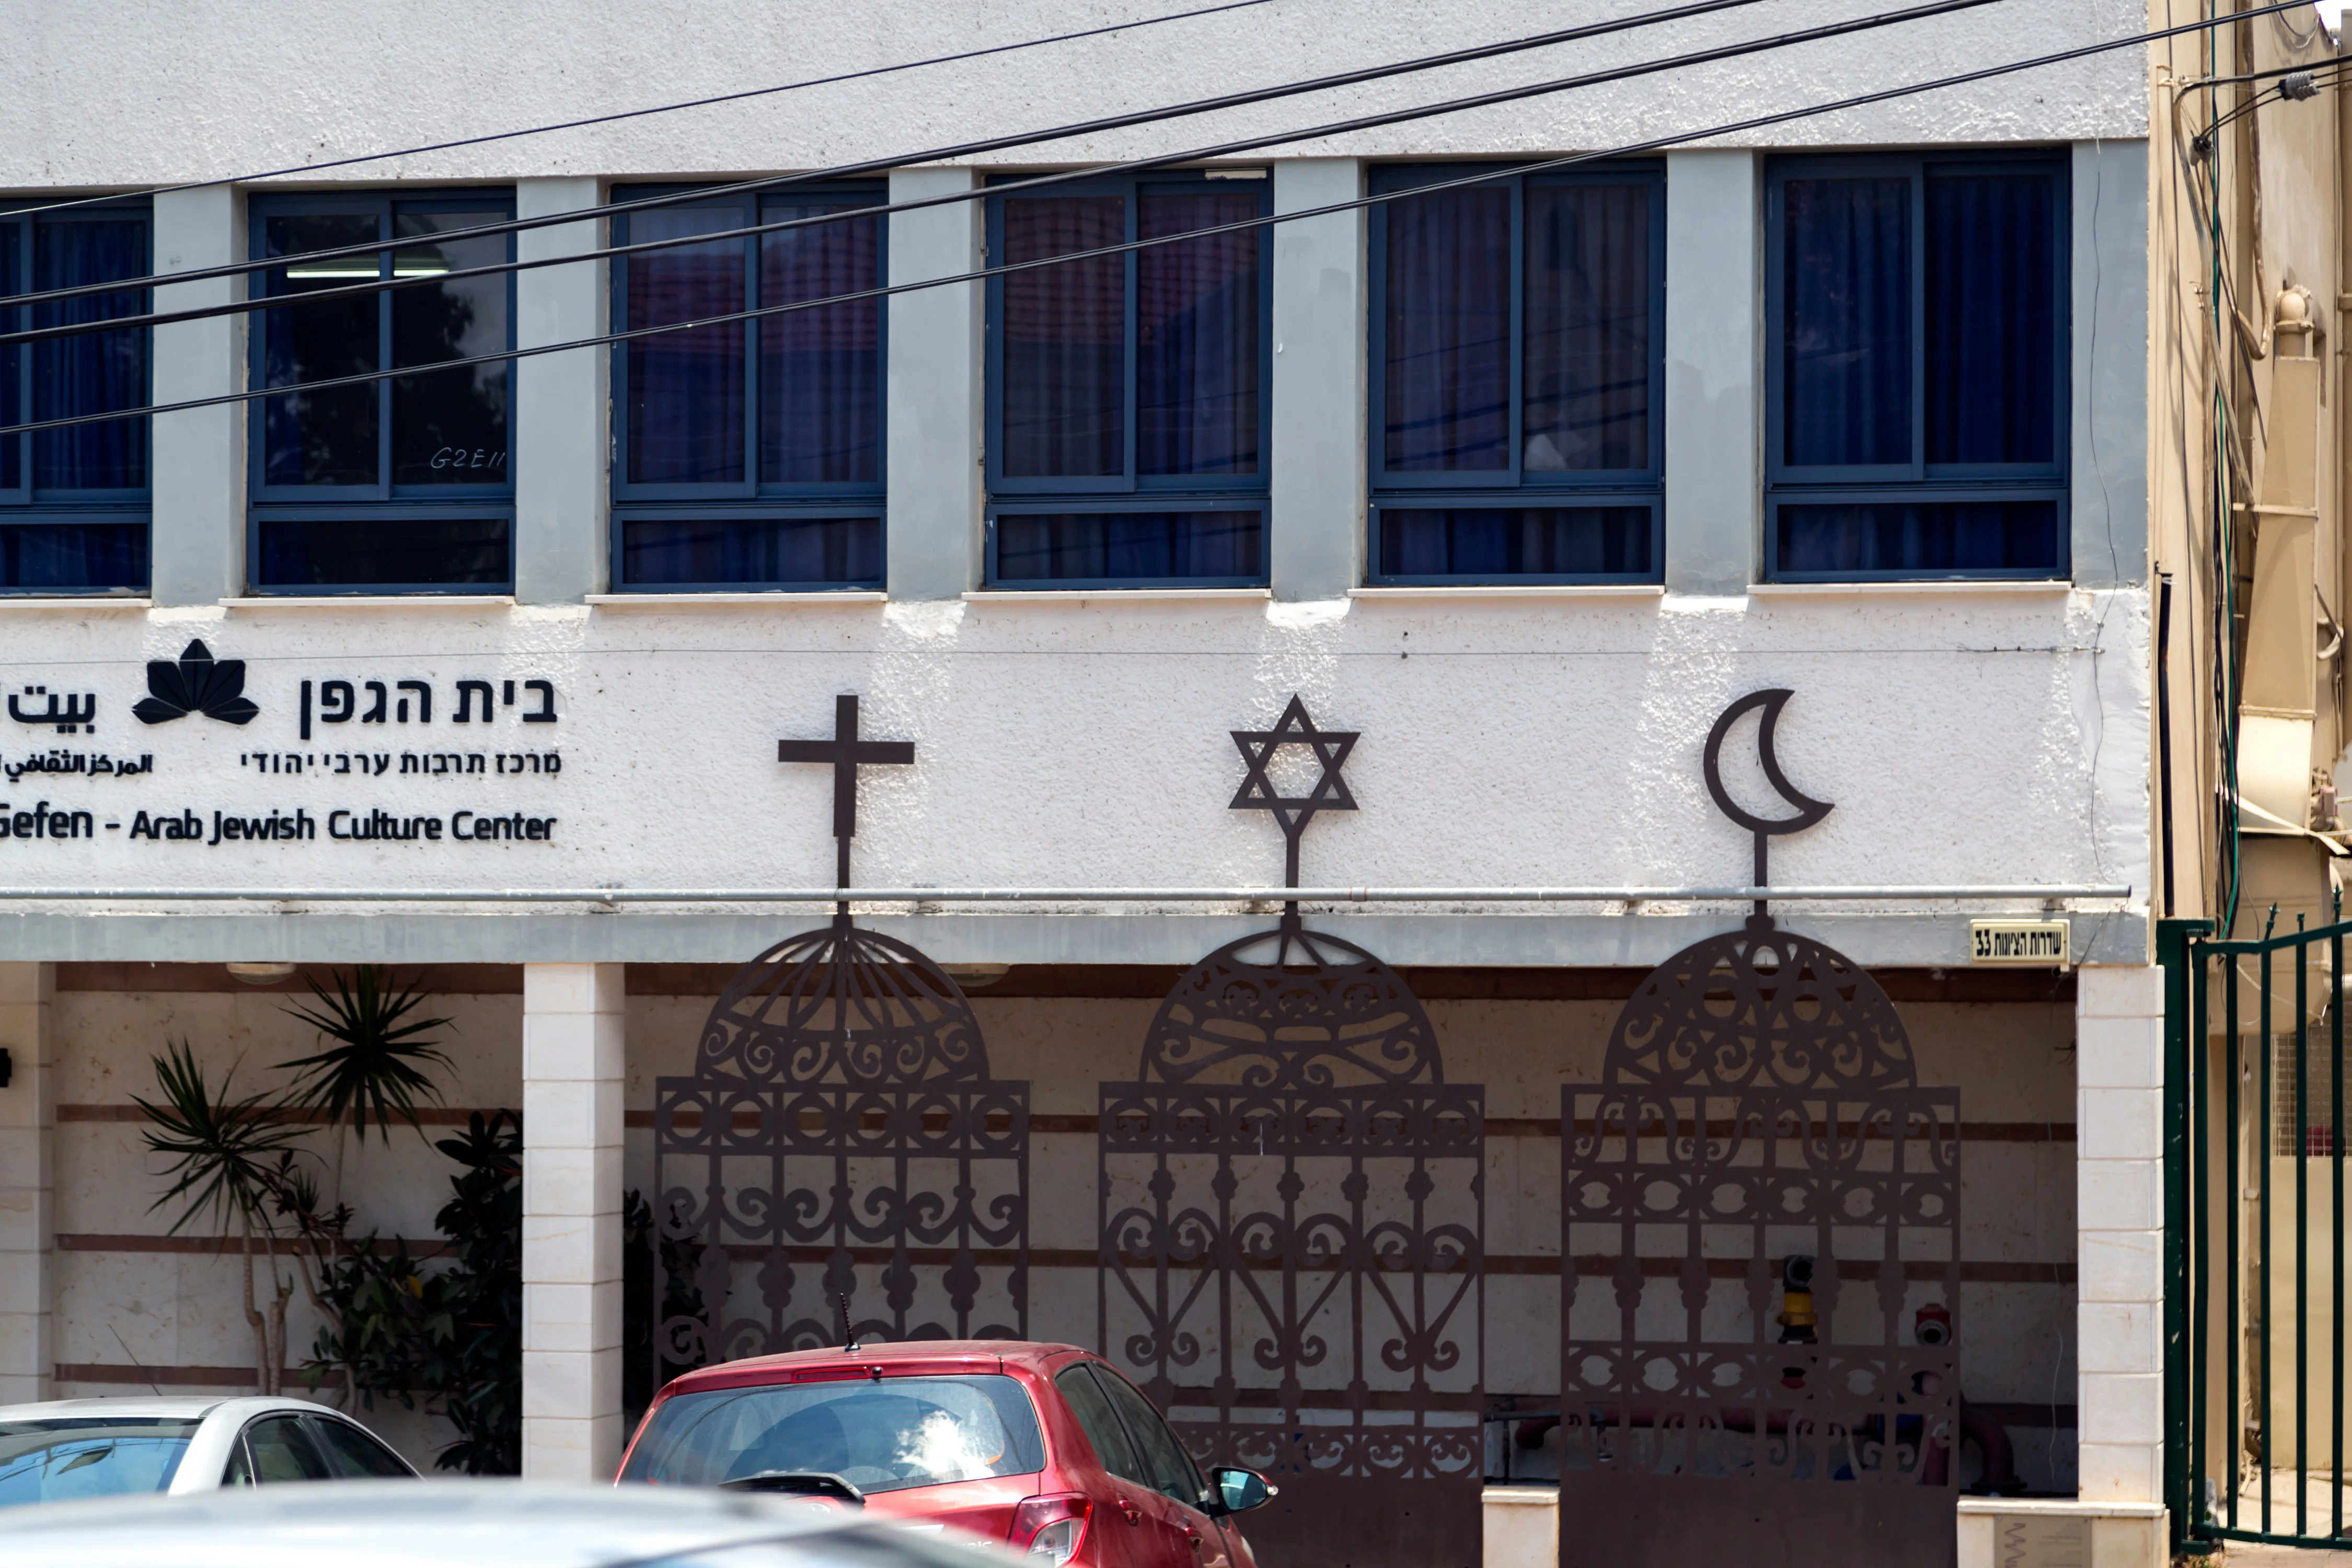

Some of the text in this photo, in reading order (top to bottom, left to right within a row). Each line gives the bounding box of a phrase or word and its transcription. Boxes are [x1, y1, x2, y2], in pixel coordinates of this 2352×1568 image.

[8, 686, 96, 734] بيت
[300, 679, 557, 741] בית הגפן
[4, 749, 86, 783] الثقافي
[87, 754, 153, 777] المركز
[241, 752, 561, 776] מרכז תרבות ערבי יהודי
[129, 809, 203, 840] Arab
[207, 809, 315, 846] Jewish
[328, 809, 442, 840] Culture
[452, 811, 558, 840] Center
[1975, 929, 2061, 956] שדרות הציונות 33
